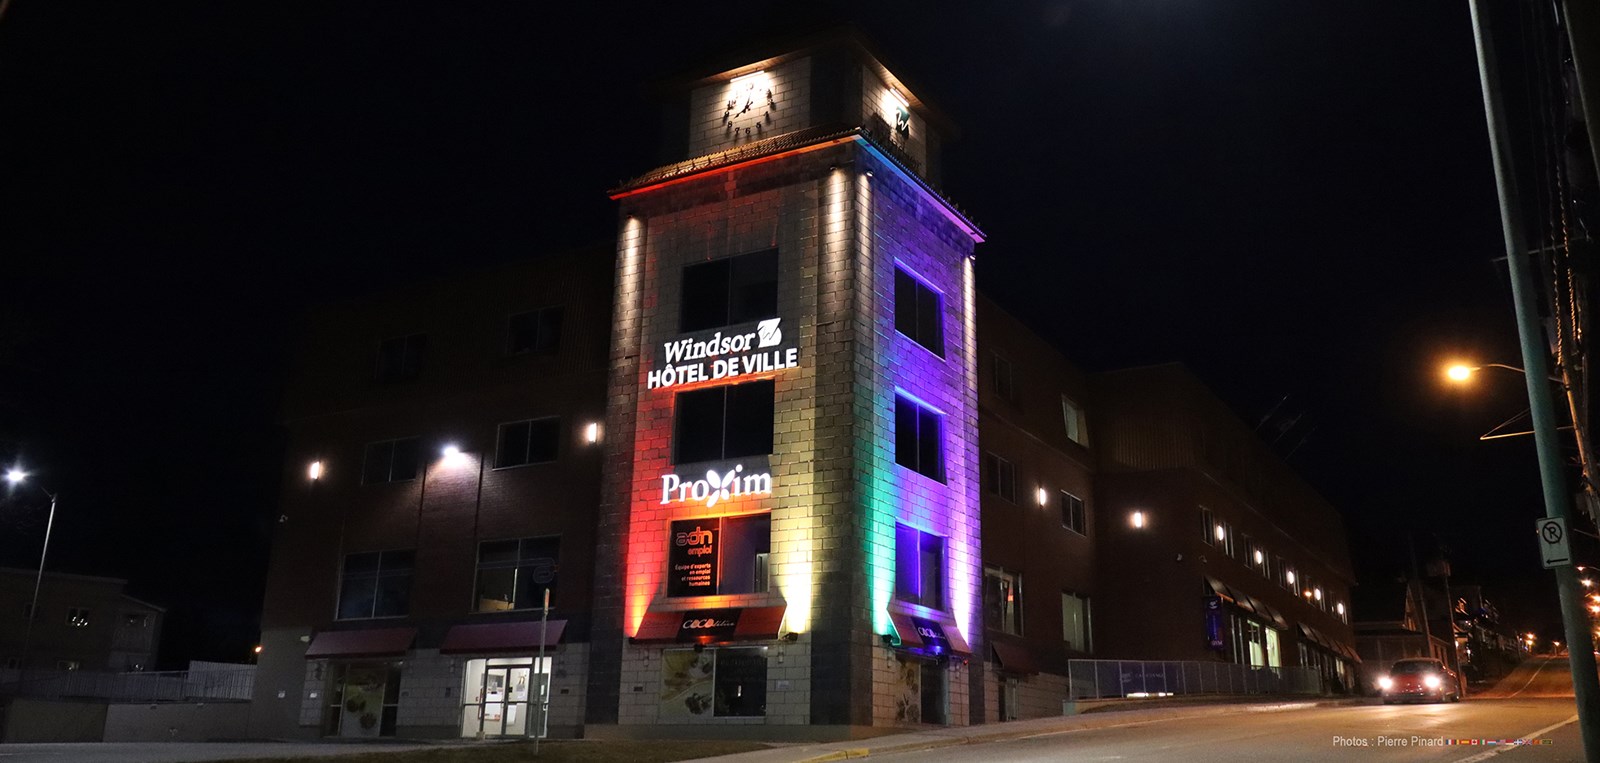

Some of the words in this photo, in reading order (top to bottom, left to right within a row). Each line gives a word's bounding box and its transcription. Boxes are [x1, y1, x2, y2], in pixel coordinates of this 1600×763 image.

[664, 332, 757, 364] Windsor
[647, 361, 709, 390] HÔTEL
[713, 357, 740, 379] DE
[742, 348, 798, 374] VILLE
[688, 546, 712, 557] emploi
